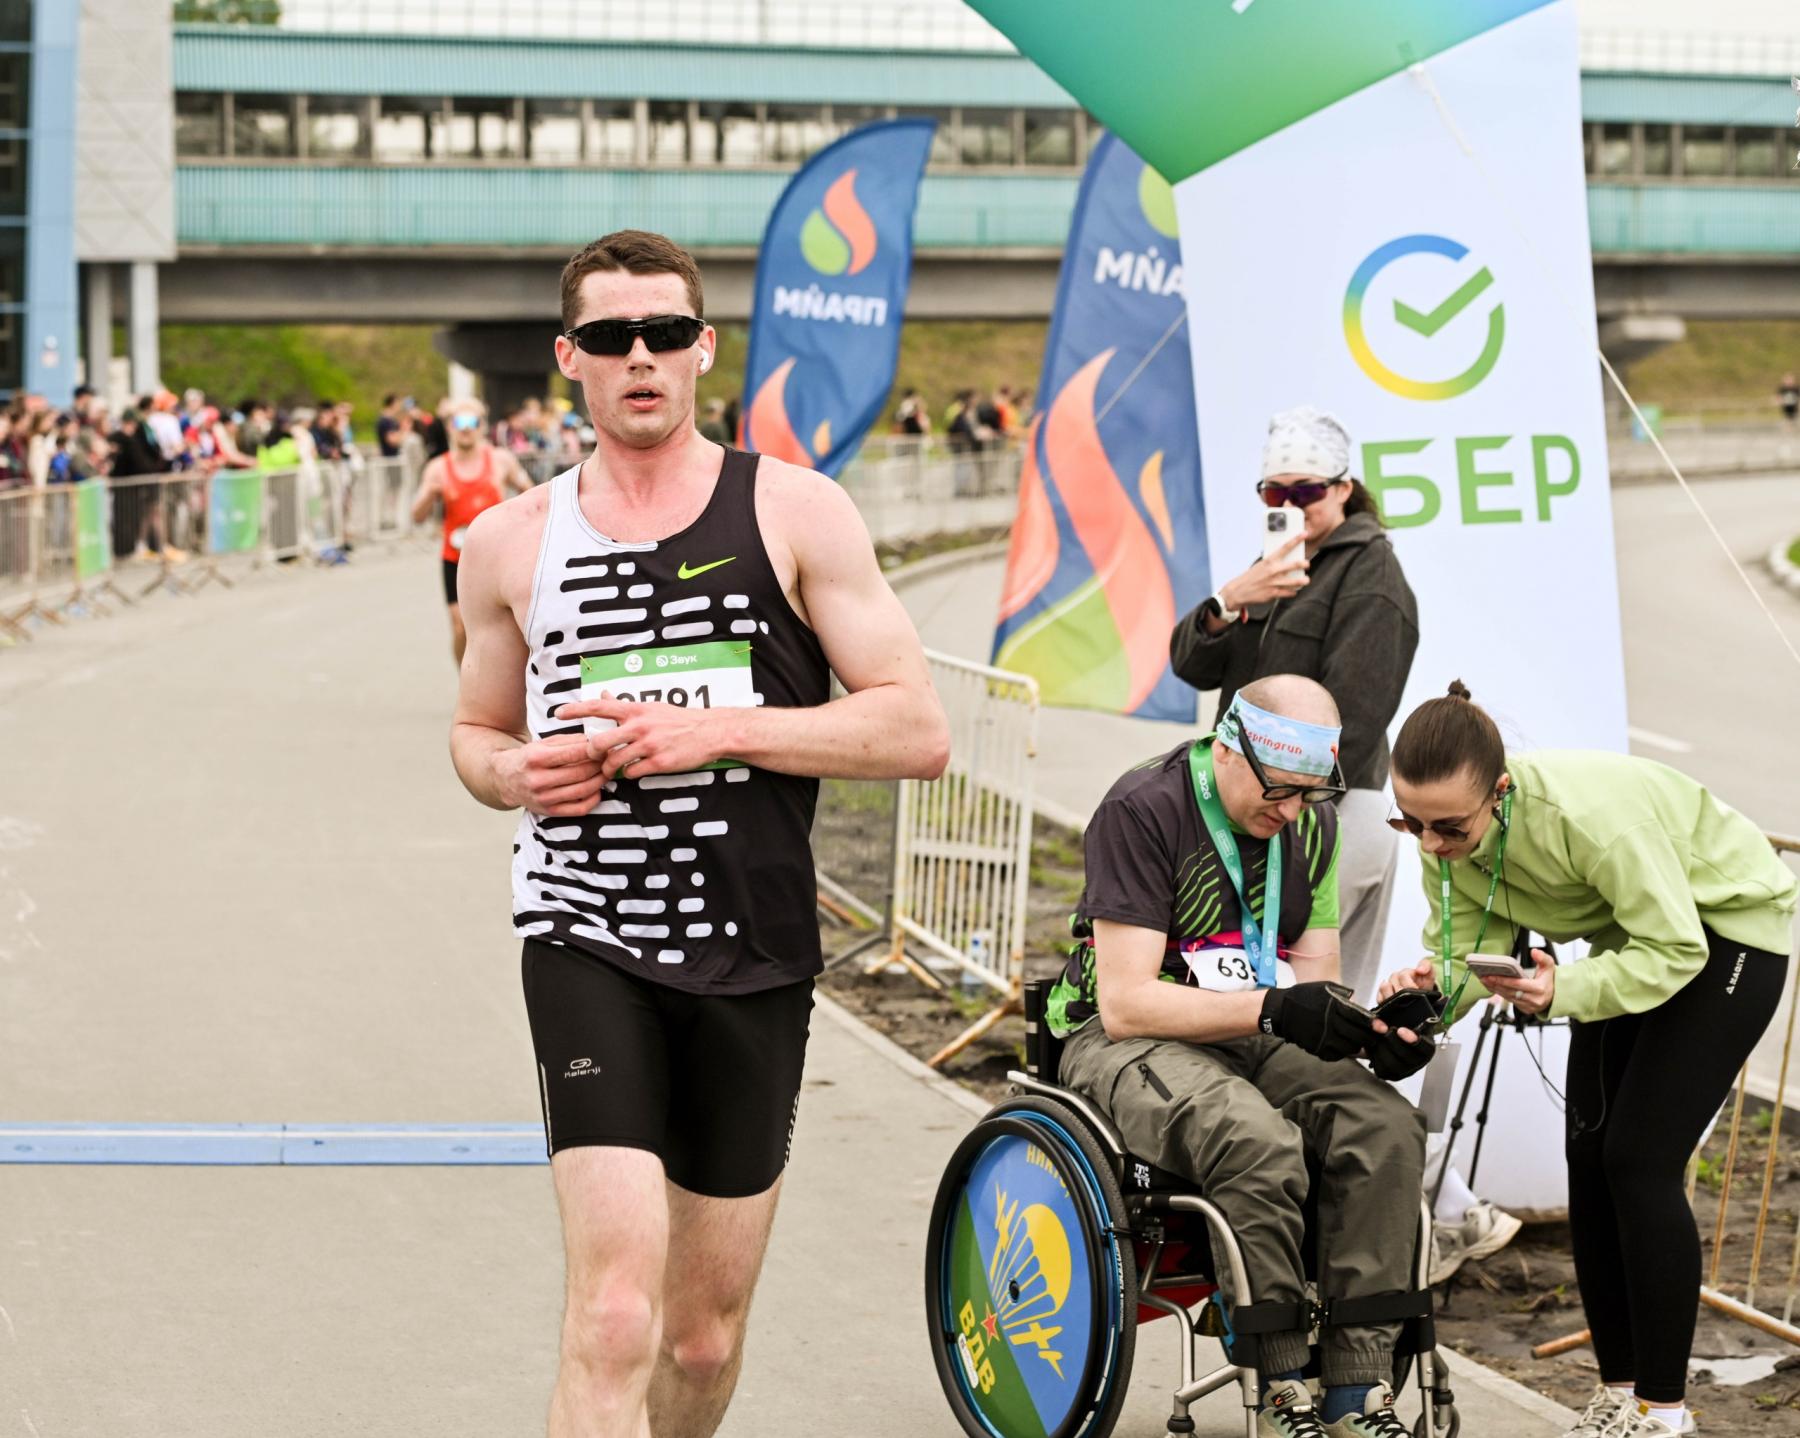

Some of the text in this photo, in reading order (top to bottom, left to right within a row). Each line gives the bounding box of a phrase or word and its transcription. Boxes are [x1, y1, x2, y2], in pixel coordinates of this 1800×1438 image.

[1361, 434, 1581, 529] БЕР
[670, 655, 697, 665] Звук
[1217, 957, 1258, 983] 63
[959, 1299, 996, 1395] ВДВ
